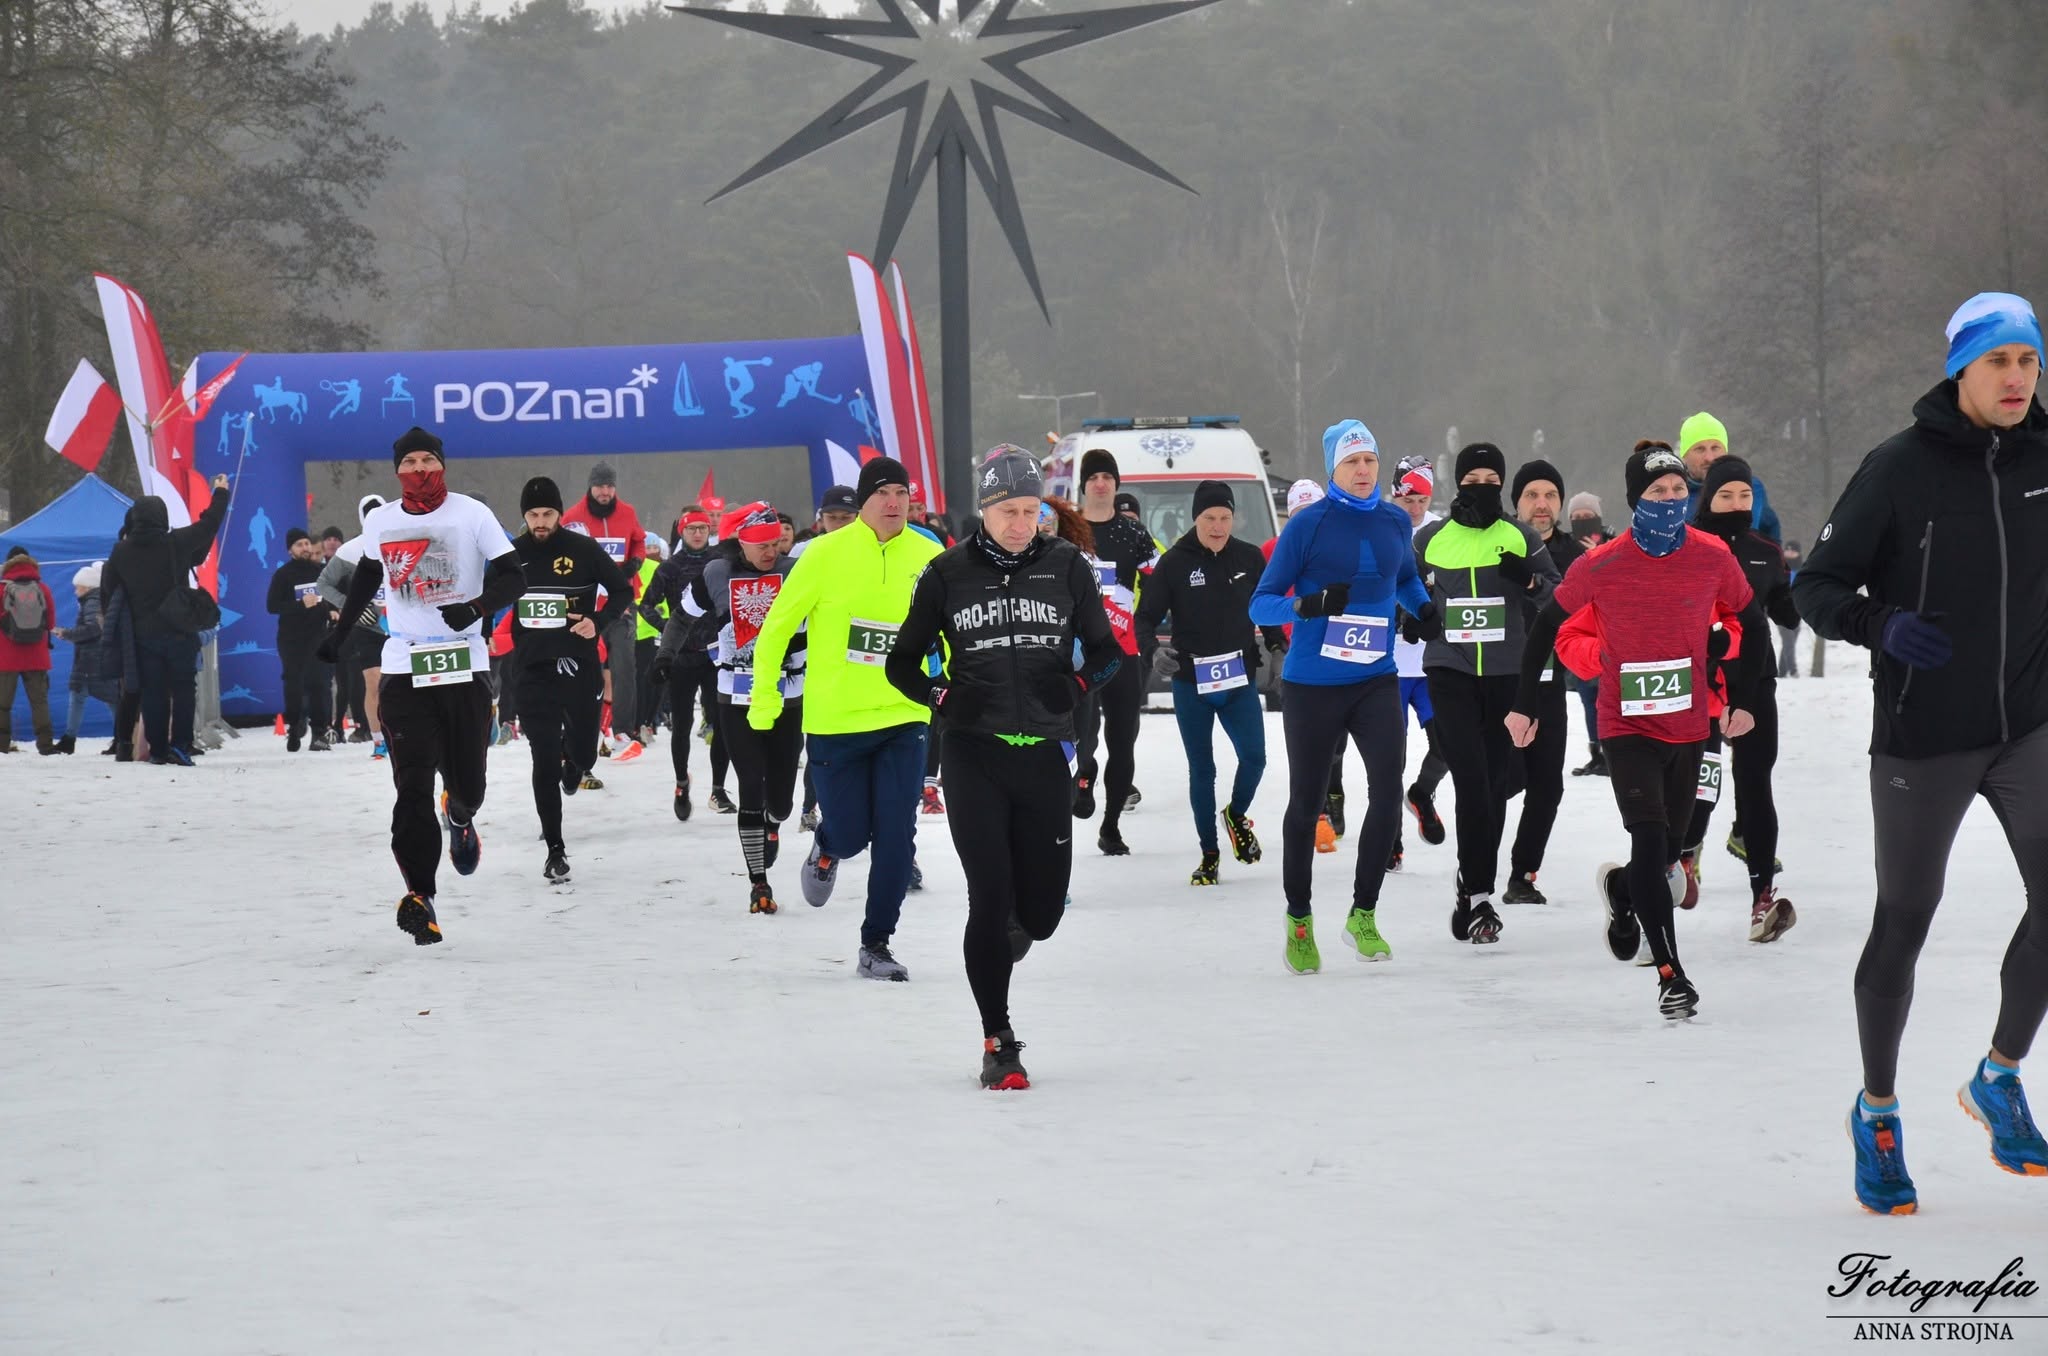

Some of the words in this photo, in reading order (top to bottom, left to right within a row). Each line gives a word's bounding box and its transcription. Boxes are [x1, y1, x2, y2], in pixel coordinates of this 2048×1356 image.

[604, 543, 618, 554] 47
[527, 602, 558, 617] 136
[1461, 609, 1488, 628] 95
[861, 631, 898, 653] 135
[1344, 627, 1371, 648] 64
[422, 652, 458, 672] 131
[1210, 663, 1230, 680] 61
[1635, 673, 1681, 697] 124
[1698, 763, 1720, 786] 96
